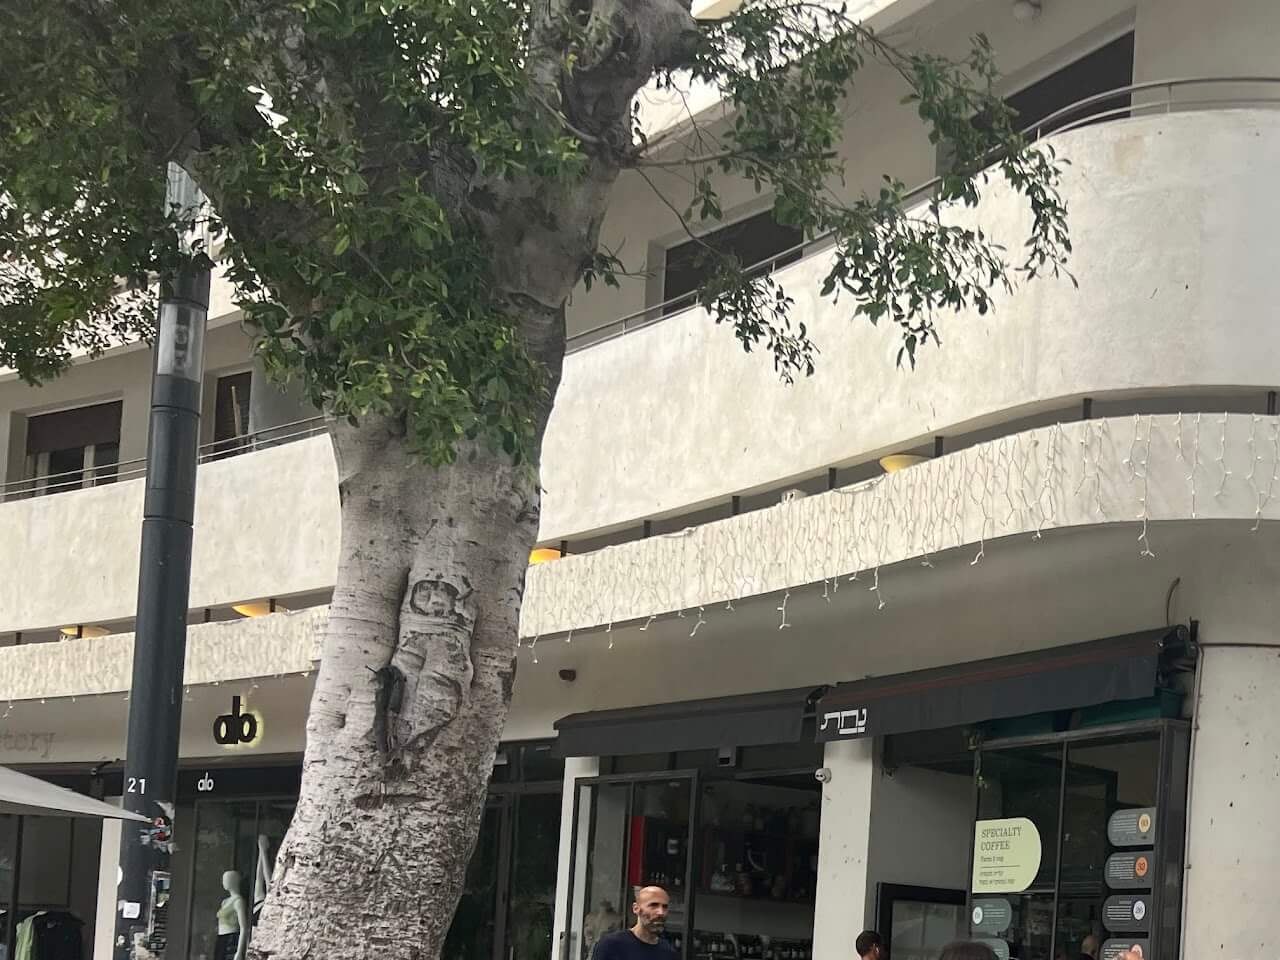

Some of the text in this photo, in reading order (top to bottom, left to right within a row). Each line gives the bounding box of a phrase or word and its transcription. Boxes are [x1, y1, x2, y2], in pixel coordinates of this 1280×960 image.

[820, 708, 868, 735] נחת
[127, 776, 147, 795] 21
[981, 826, 1022, 839] SPECIALTY
[980, 840, 1010, 852] COFFEE
